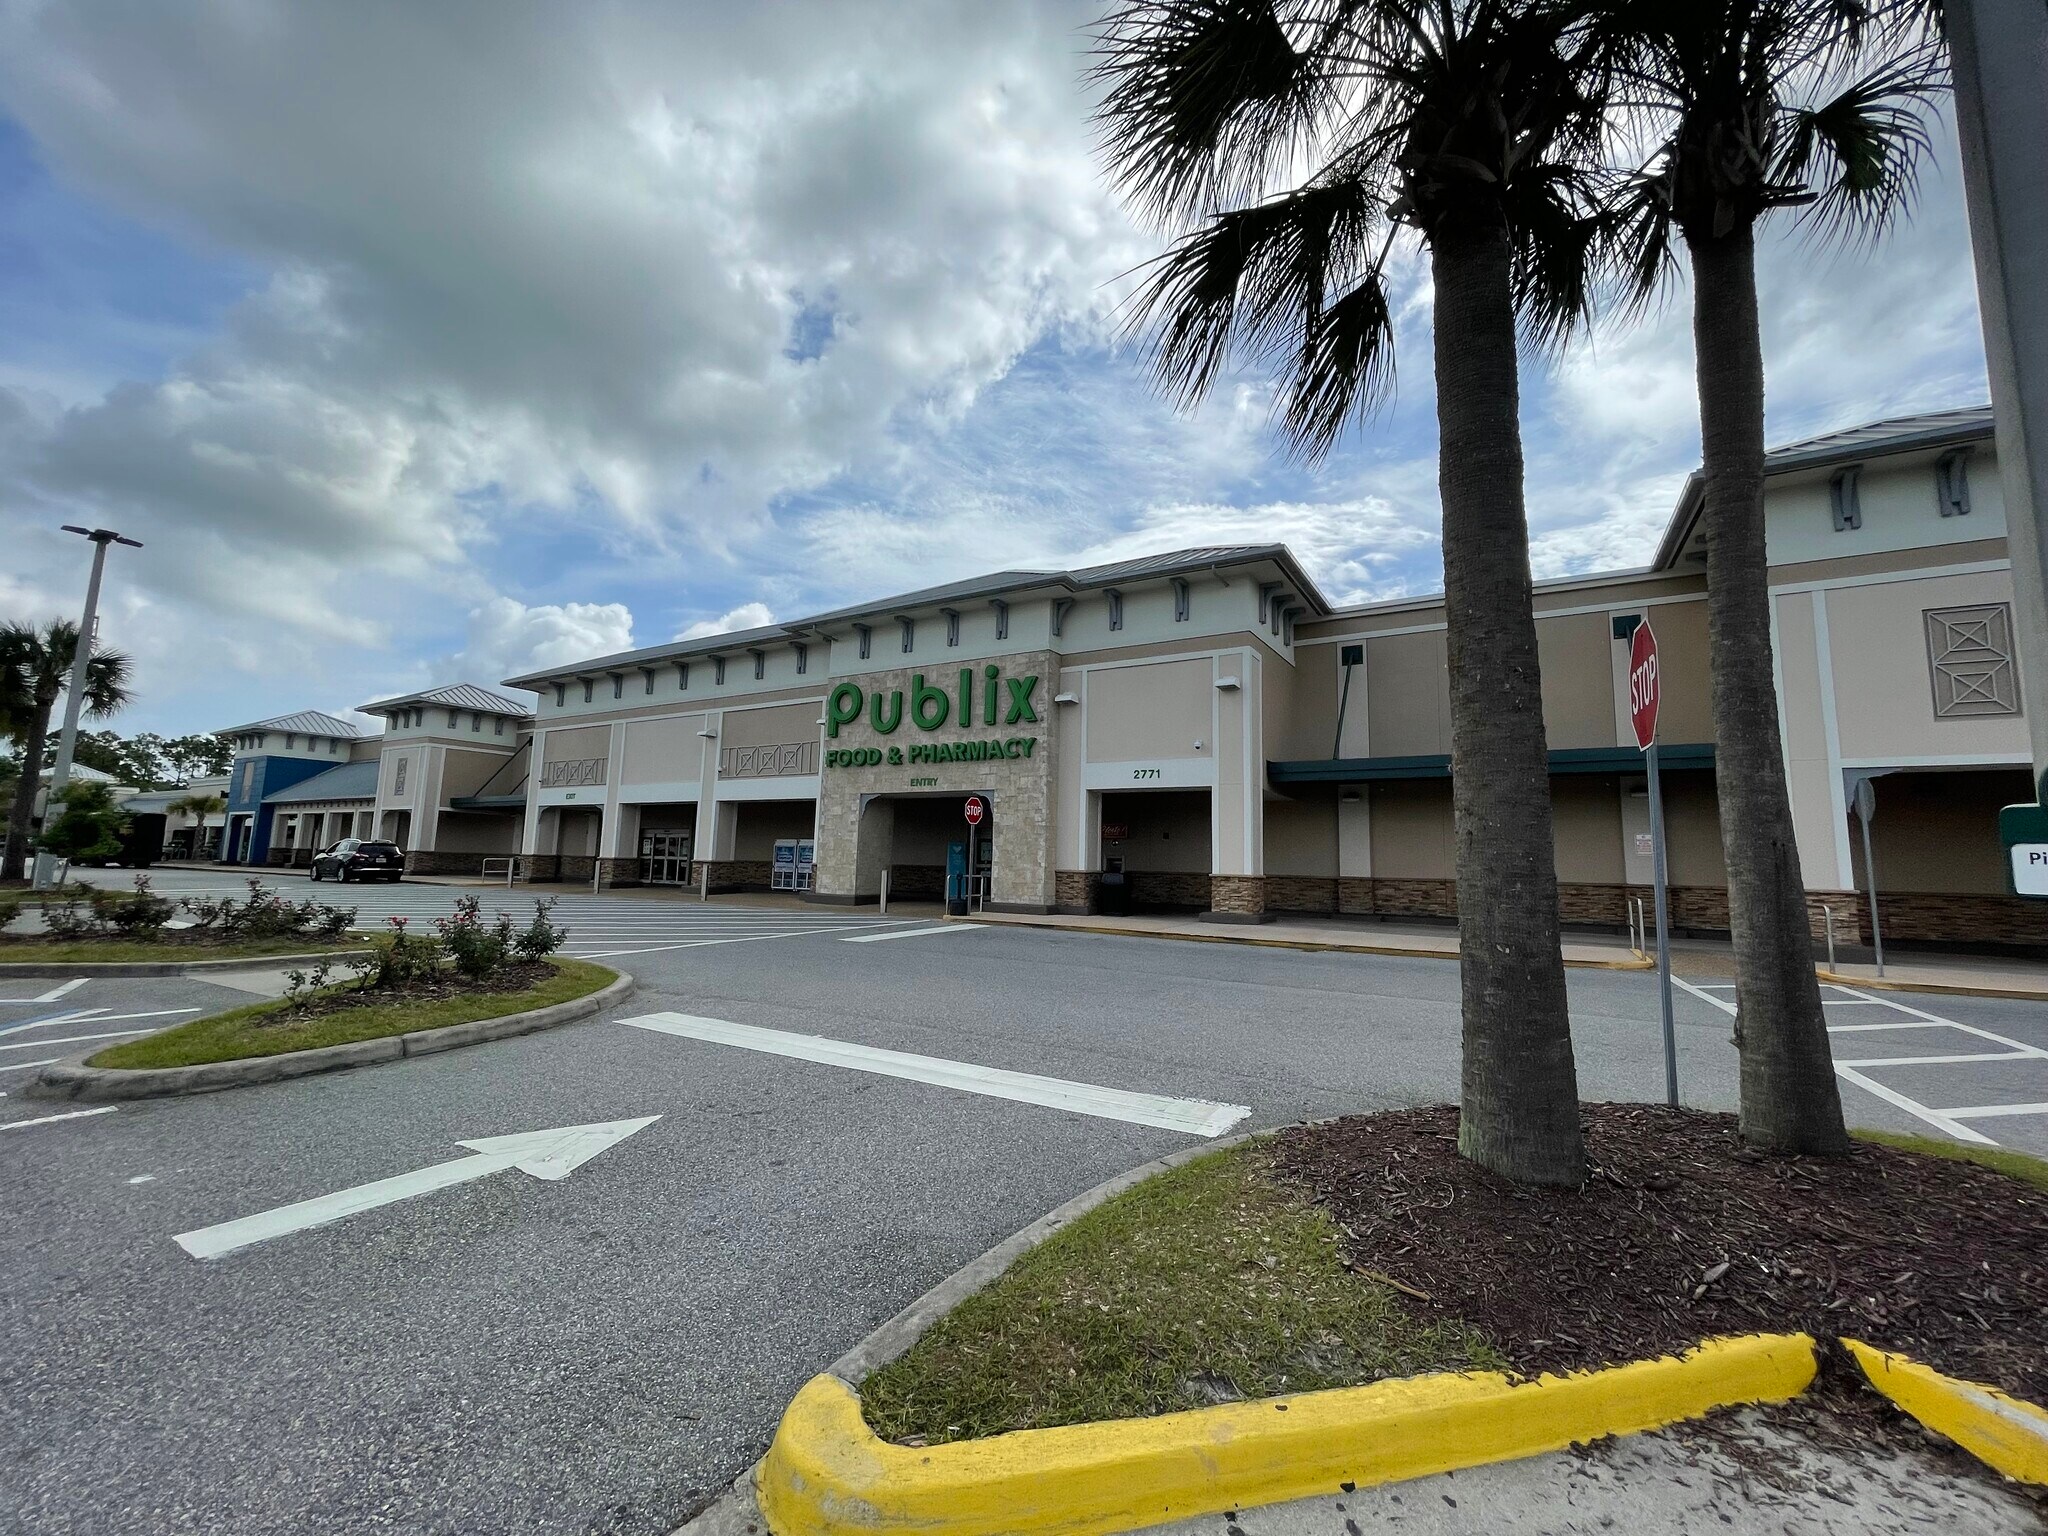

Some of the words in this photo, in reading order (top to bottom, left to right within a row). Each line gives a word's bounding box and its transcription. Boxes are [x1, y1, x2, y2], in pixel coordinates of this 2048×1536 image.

[1631, 653, 1656, 715] STOP
[827, 664, 1039, 738] Publix
[826, 747, 882, 768] FOOD
[887, 745, 903, 765] &
[907, 737, 1037, 763] PHARMACY
[910, 777, 939, 787] ENTRY
[1133, 769, 1160, 779] 2771
[966, 805, 982, 816] STOP
